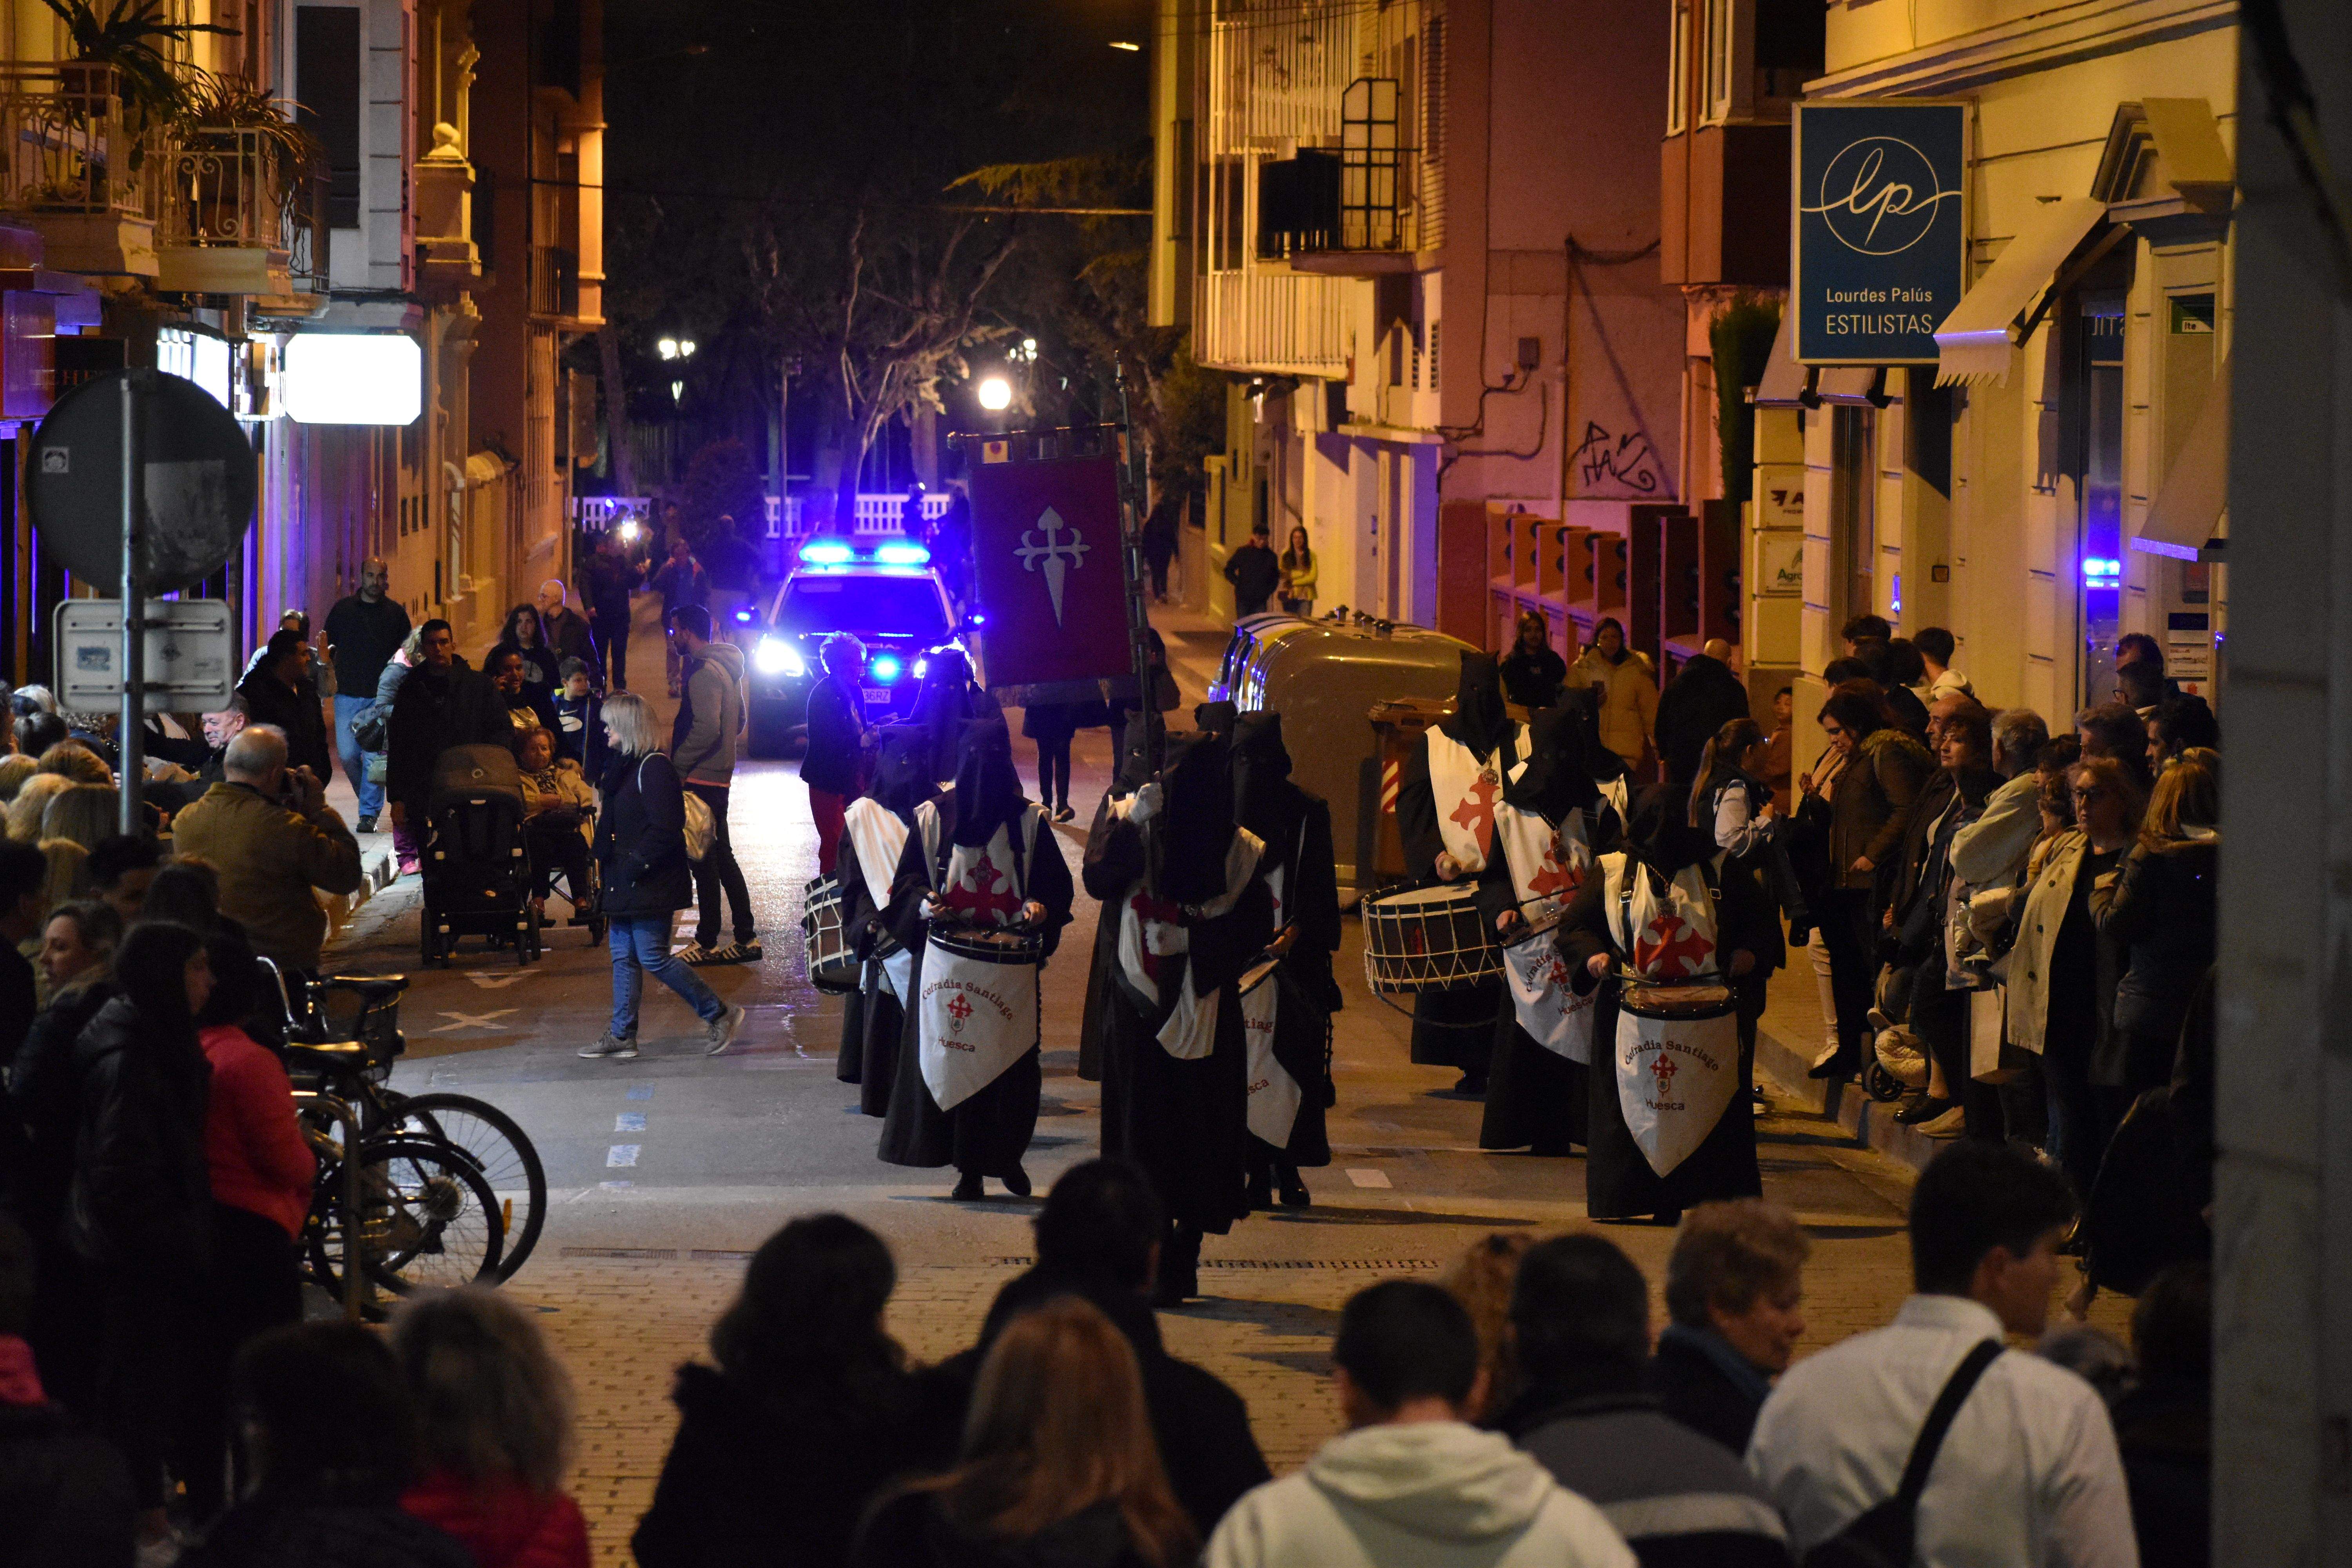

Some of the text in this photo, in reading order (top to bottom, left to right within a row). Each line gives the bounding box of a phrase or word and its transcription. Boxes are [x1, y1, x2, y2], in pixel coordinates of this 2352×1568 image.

[1826, 288, 1933, 303] Lourdes Palús
[1826, 314, 1932, 334] ESTILISTAS
[1558, 996, 1593, 1016] Huesca
[1625, 1040, 1719, 1071] Cofradia Santiago
[1645, 1098, 1685, 1111] Huesca
